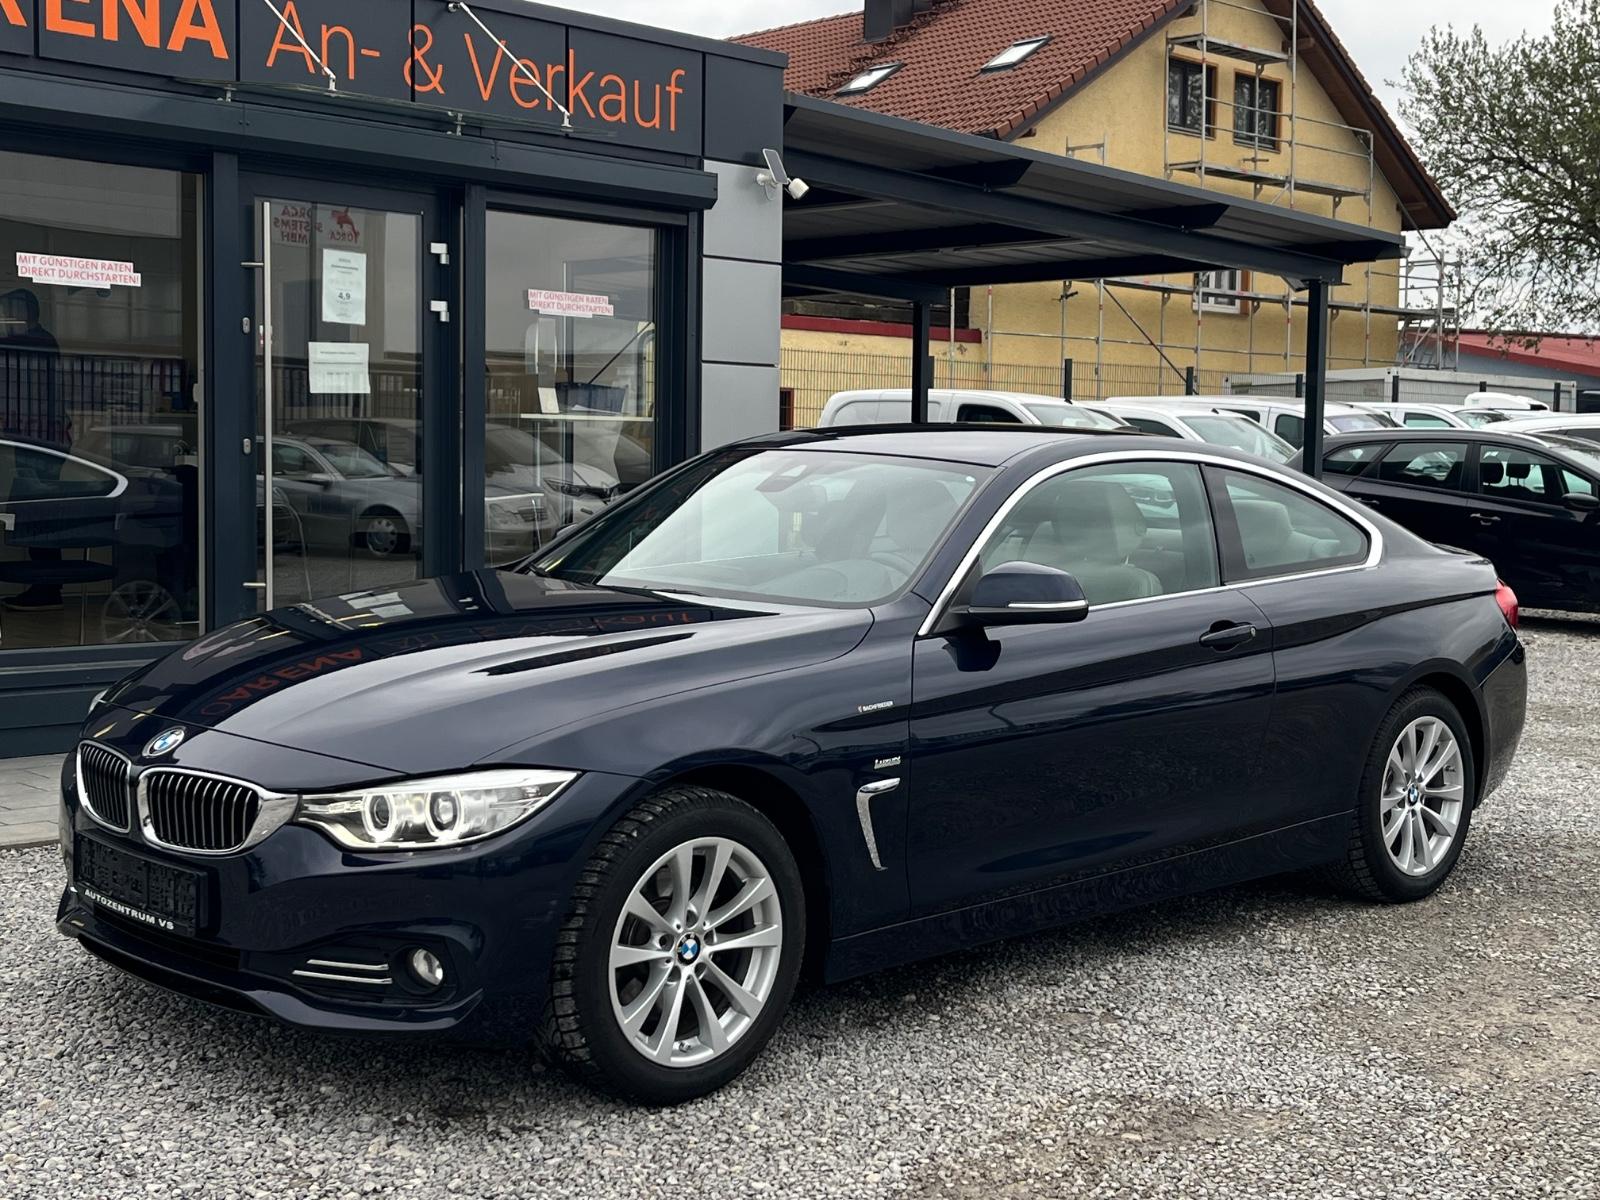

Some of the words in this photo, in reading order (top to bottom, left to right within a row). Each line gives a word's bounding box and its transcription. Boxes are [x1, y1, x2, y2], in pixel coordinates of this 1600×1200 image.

[265, 0, 381, 81] An-
[402, 23, 446, 95] &
[464, 32, 686, 132] Verkauf
[18, 254, 39, 265] MIT
[101, 262, 132, 273] RATEN
[20, 265, 56, 277] DIREKT
[58, 269, 139, 284] DURCHSTARTEN!
[529, 291, 543, 299] MIT
[531, 300, 555, 309] DIREKT
[84, 888, 156, 924] AUTOZENTRUM
